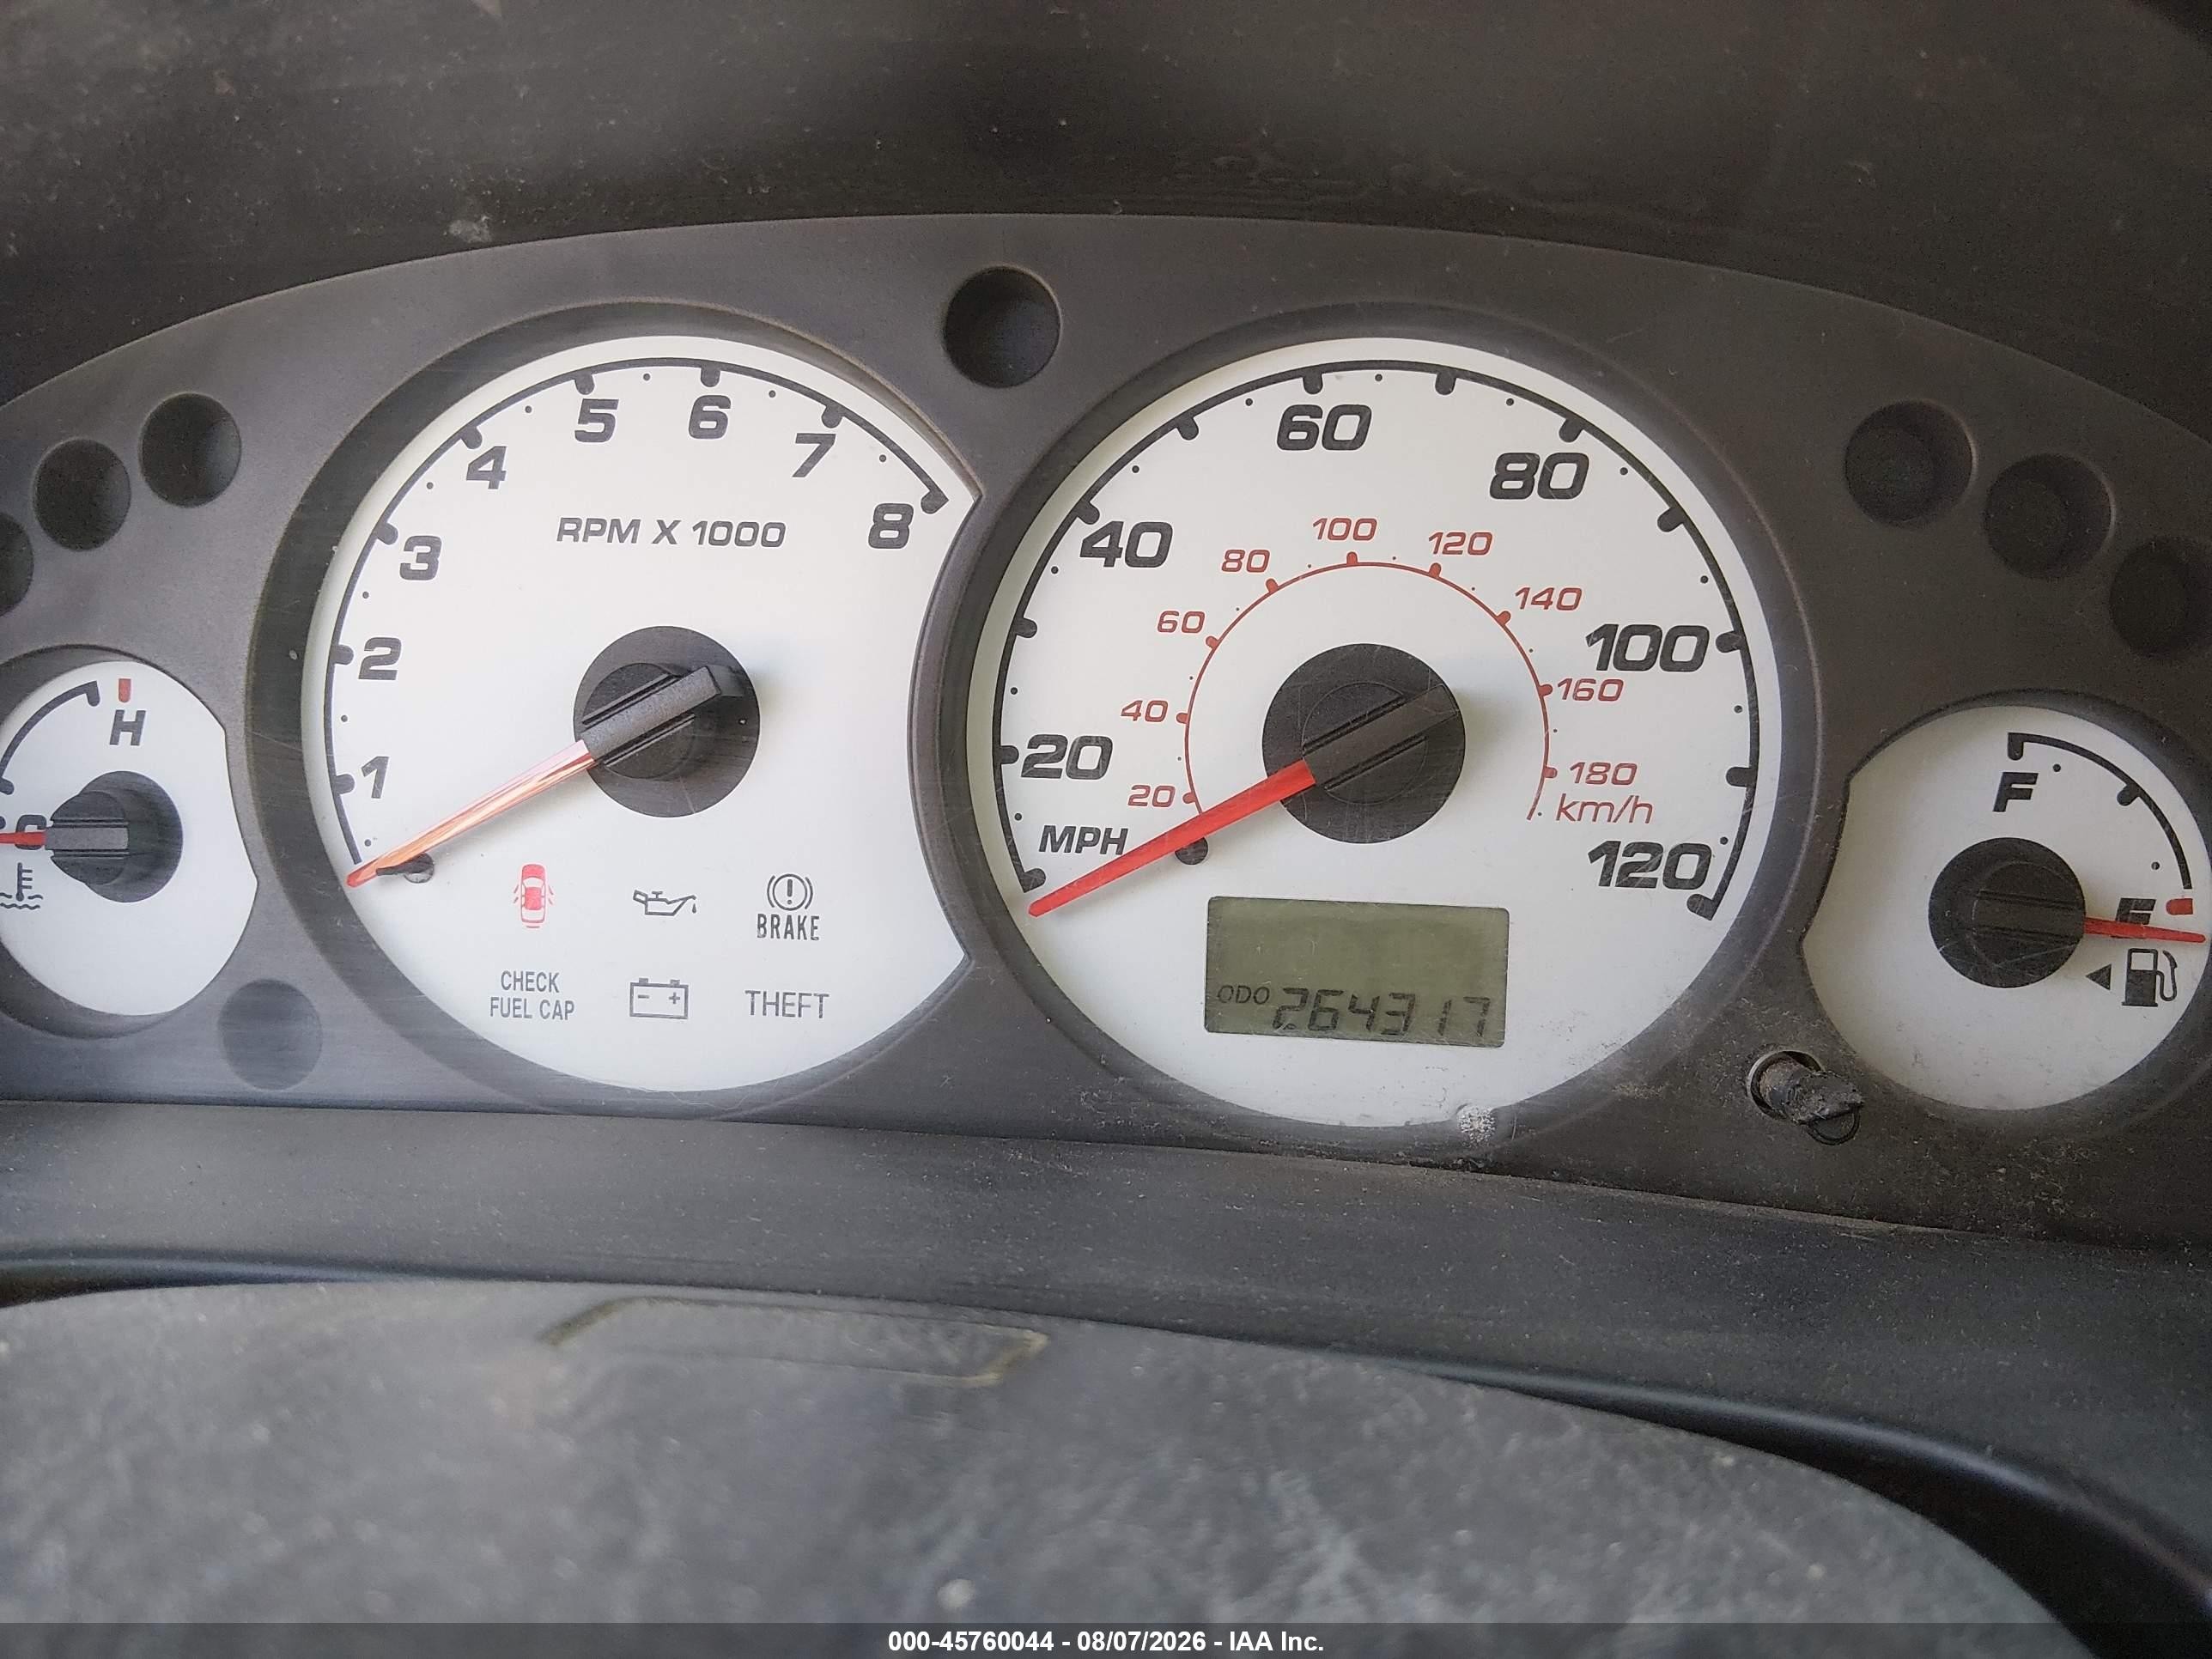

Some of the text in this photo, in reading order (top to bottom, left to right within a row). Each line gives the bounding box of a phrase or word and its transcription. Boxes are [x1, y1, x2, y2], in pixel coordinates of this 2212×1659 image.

[574, 398, 619, 443] 5
[688, 394, 732, 440] 6
[1276, 404, 1372, 451] 60
[465, 445, 507, 490] 4
[792, 432, 836, 478] 7
[1489, 452, 1589, 500] 80
[556, 517, 787, 548] RPM X 1000
[867, 502, 915, 550] 8
[1079, 520, 1173, 568] 40
[1312, 517, 1378, 541] 100
[1428, 532, 1493, 556] 120
[398, 534, 442, 582] 3
[1221, 549, 1271, 574] 80
[1515, 586, 1583, 611] 140
[1157, 611, 1206, 634] 60
[358, 636, 402, 681] 2
[1585, 623, 1711, 673] 100
[1557, 678, 1625, 702] 160
[109, 709, 147, 746] H
[1121, 700, 1169, 723] 40
[1020, 733, 1114, 781] 20
[1570, 762, 1638, 786] 180
[361, 756, 390, 799] 1
[1127, 784, 1176, 808] 20
[1992, 771, 2039, 813] F
[1555, 794, 1653, 824] km/h
[1038, 824, 1128, 856] MPH
[1587, 840, 1712, 890] 120
[757, 913, 820, 941] BRAKE
[501, 970, 560, 994] CHECK
[489, 996, 575, 1021] FUEL CAP
[744, 989, 830, 1019] THEFT
[1217, 985, 1492, 1037] ODO 264317
